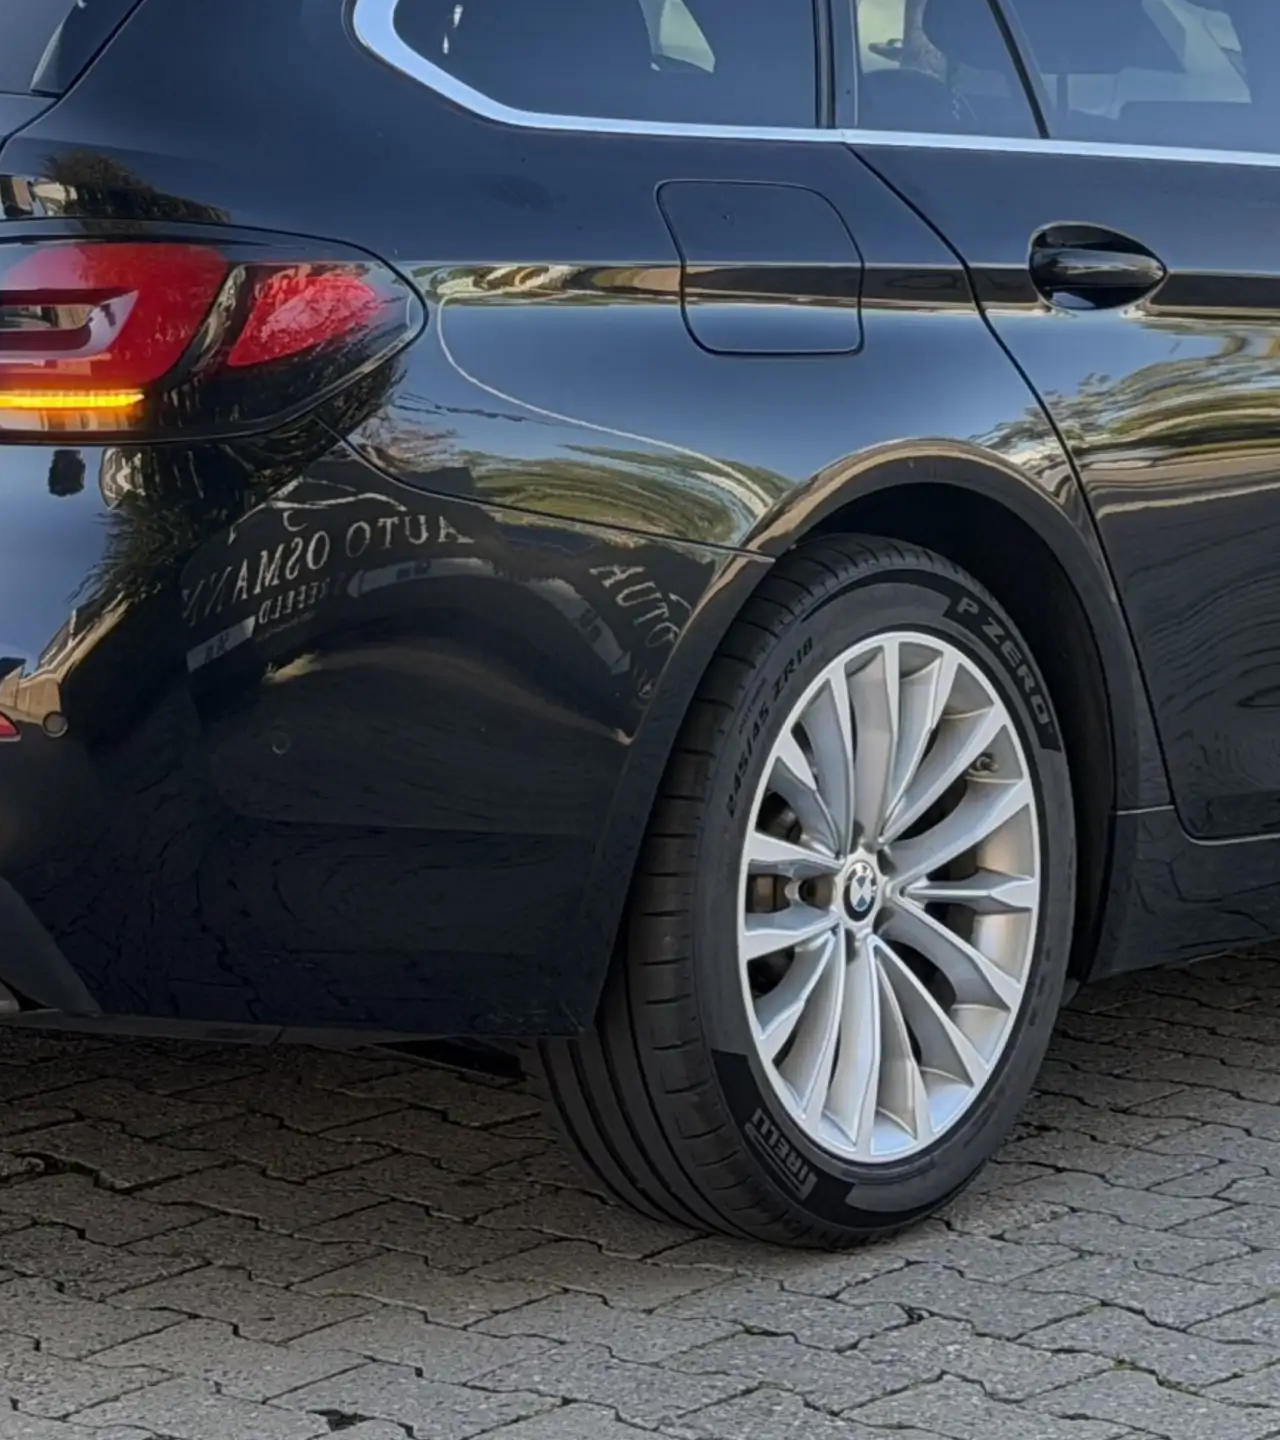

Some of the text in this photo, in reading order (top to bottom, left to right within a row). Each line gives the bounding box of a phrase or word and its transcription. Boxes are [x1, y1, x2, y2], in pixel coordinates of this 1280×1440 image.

[772, 635, 815, 703] ZR18
[956, 595, 1052, 725] P ZERO
[743, 1107, 818, 1201] PIRELLI
